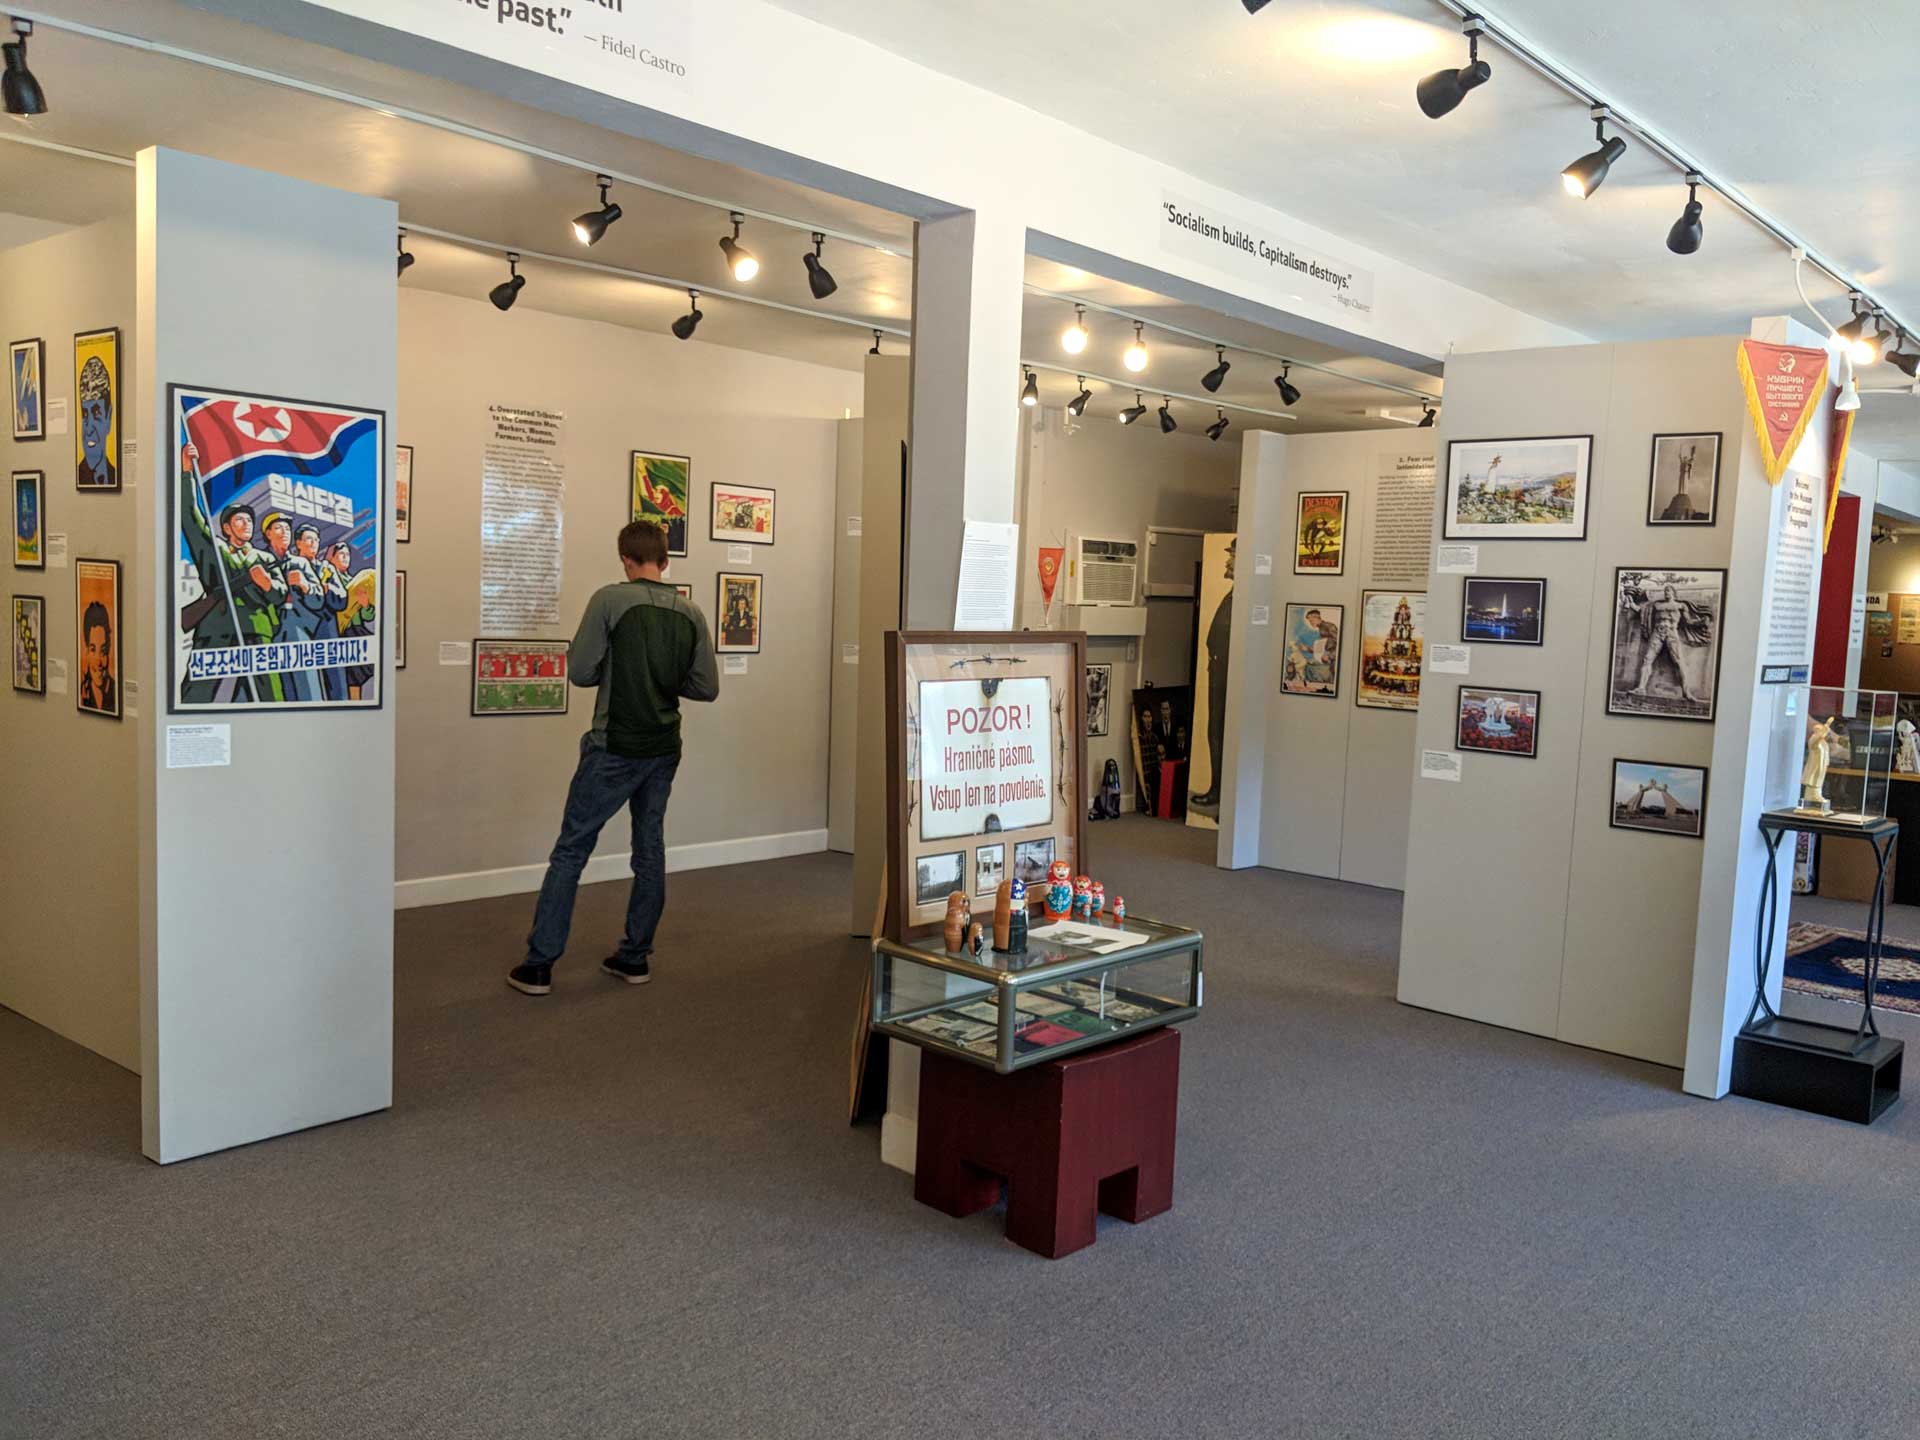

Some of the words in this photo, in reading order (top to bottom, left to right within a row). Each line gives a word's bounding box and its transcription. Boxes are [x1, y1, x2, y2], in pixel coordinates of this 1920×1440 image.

[602, 34, 636, 60] Fidel
[639, 48, 686, 77] Castro
[1163, 202, 1220, 240] “Socialism
[1222, 225, 1256, 256] builds,
[1259, 240, 1308, 274] Capitalism
[1310, 260, 1352, 290] destroys.”
[497, 406, 535, 416] Overstated
[536, 411, 562, 420] Tributes
[514, 417, 542, 426] Common
[526, 436, 556, 446] Students
[268, 473, 354, 528] 일심단결
[944, 743, 995, 773] Hraničné
[1000, 742, 1035, 771] pásmo.
[930, 784, 961, 813] Vstup
[965, 781, 980, 807] len
[984, 784, 995, 805] na
[999, 774, 1046, 807] povolenie.
